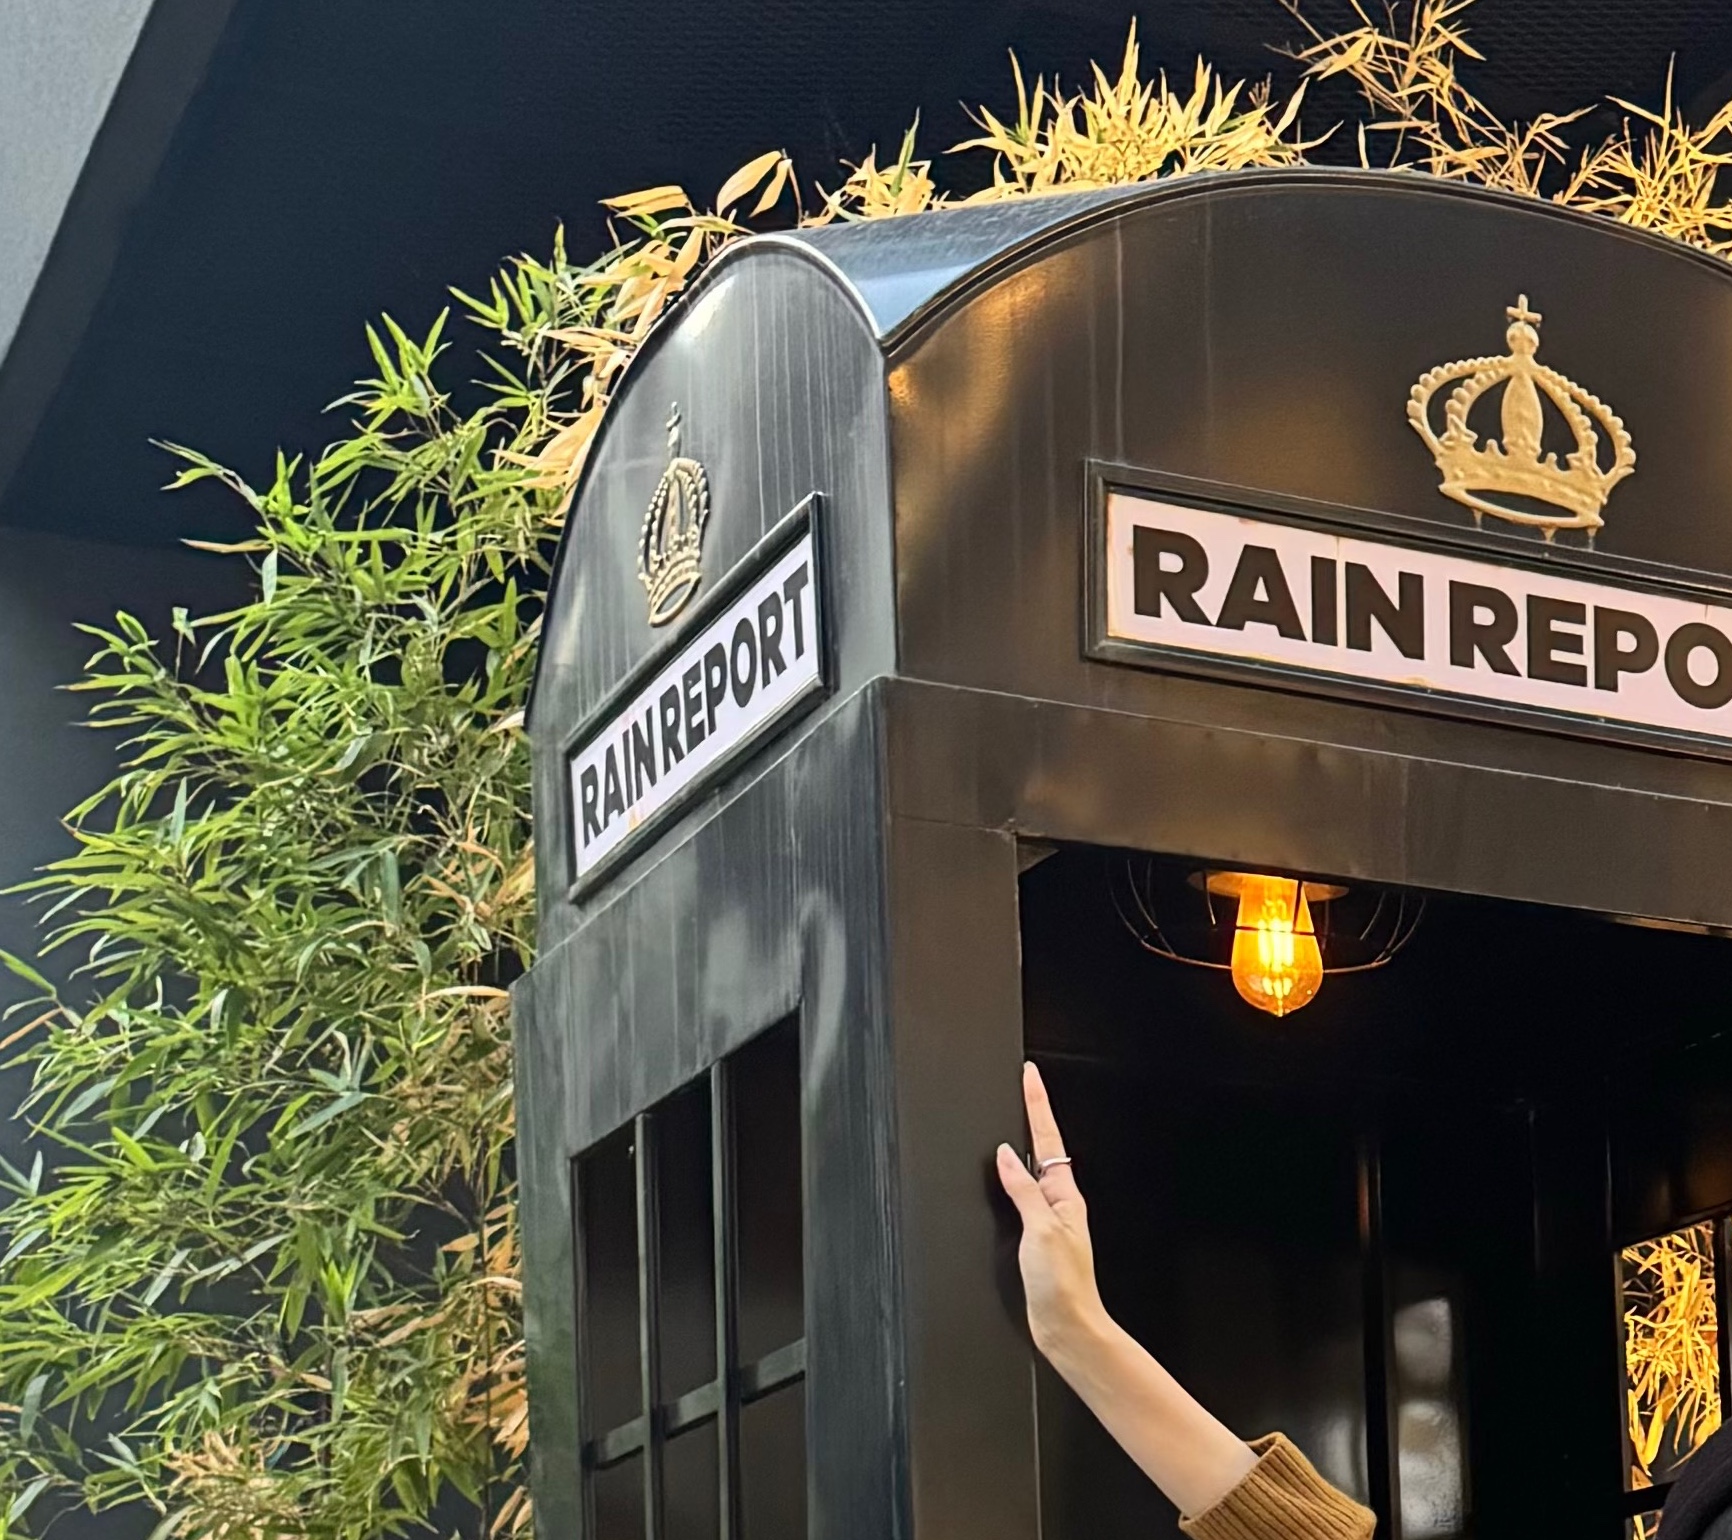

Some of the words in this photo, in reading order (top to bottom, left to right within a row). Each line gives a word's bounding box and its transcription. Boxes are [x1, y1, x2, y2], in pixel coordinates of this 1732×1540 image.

[1132, 524, 1426, 661] RAIN
[580, 705, 657, 849] RAIN
[659, 560, 809, 776] REPORT
